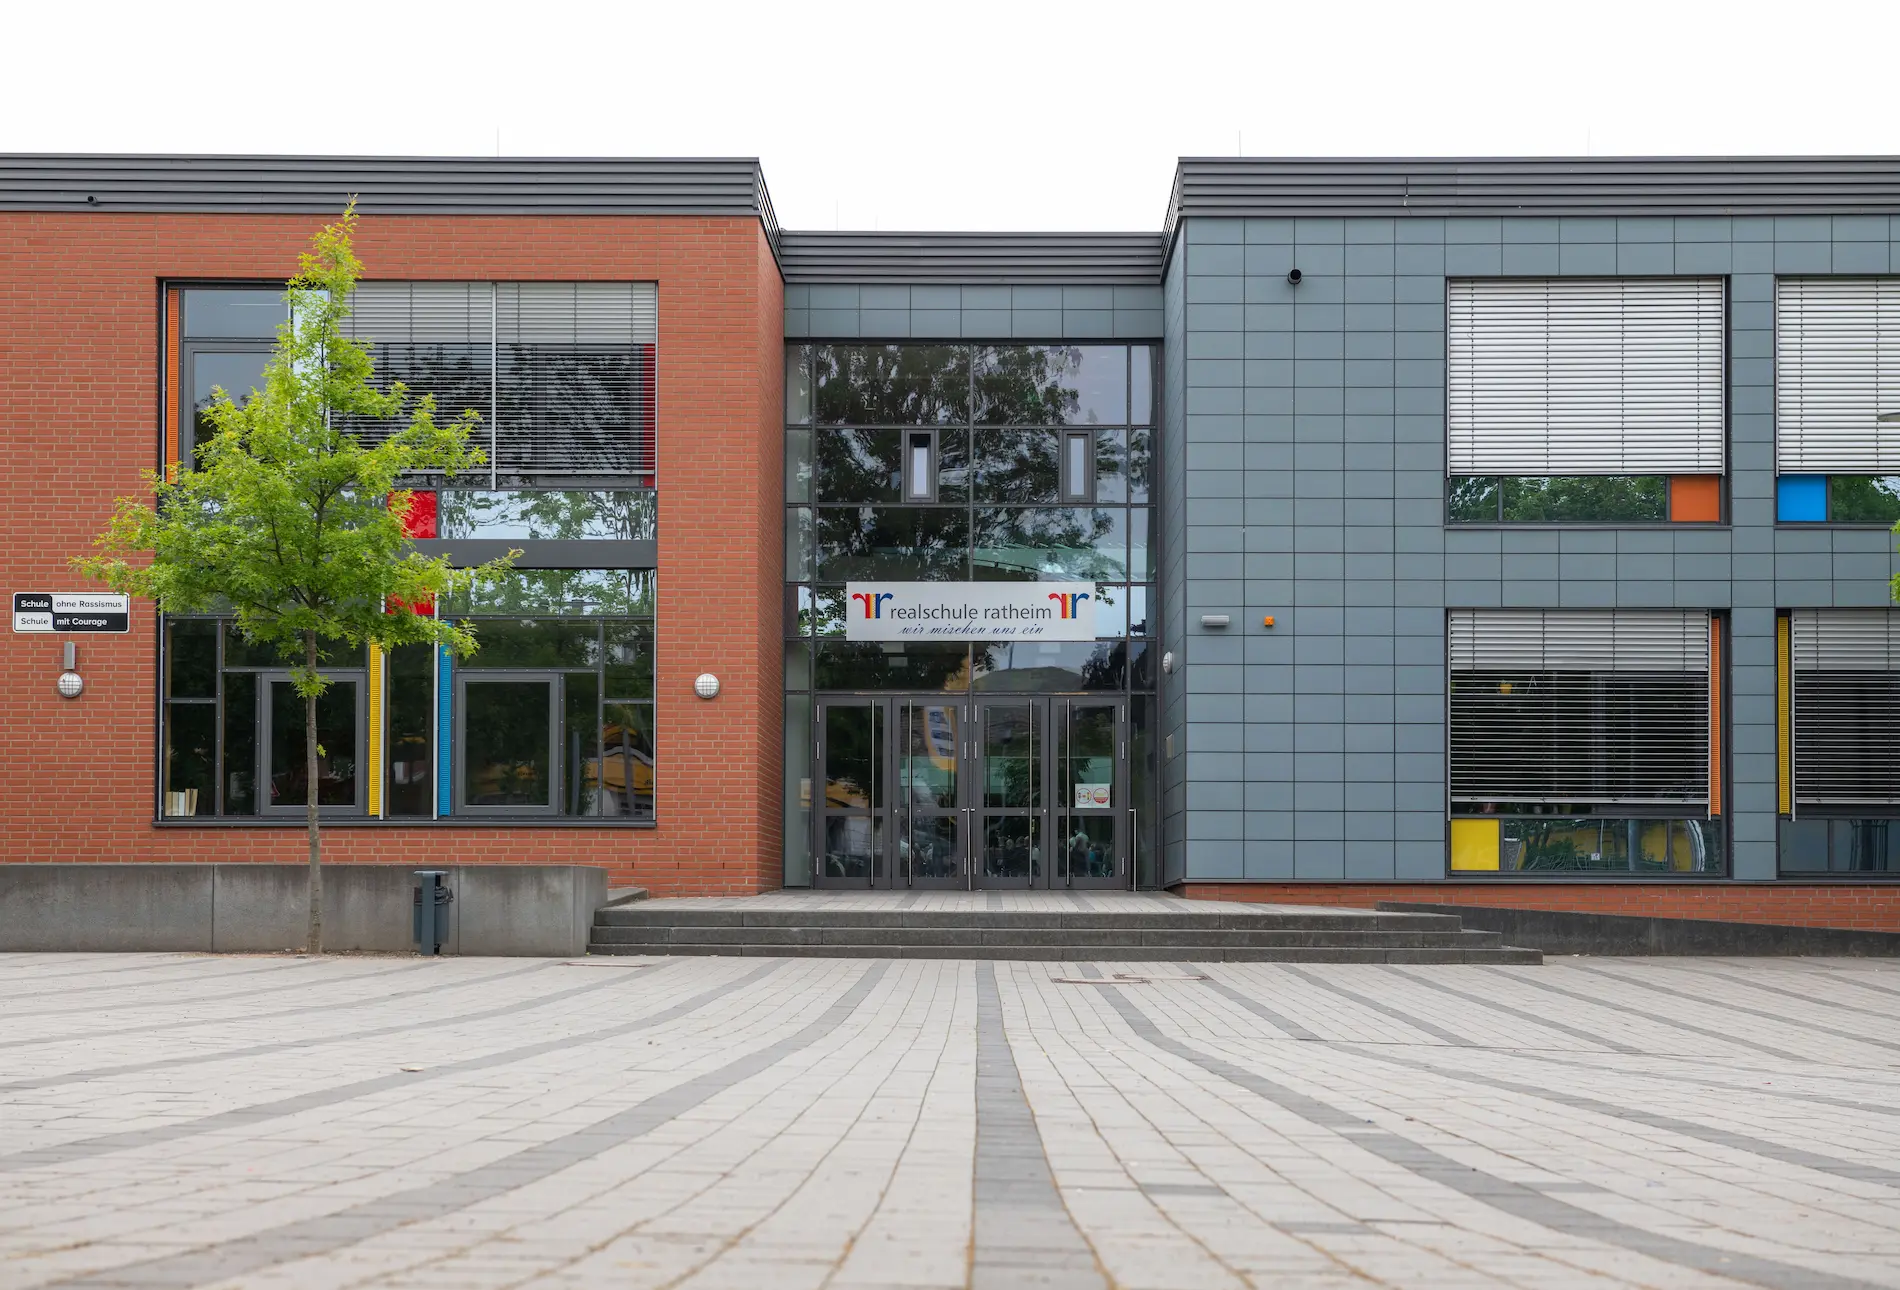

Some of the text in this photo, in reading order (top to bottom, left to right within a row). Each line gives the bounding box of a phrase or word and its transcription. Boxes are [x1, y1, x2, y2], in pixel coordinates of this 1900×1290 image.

[20, 600, 122, 608] Schule ohne Rassismus
[890, 603, 1052, 620] realschule ratheim
[20, 617, 108, 627] Schule mit Courage
[898, 620, 1044, 635] wir mischen uns ein
